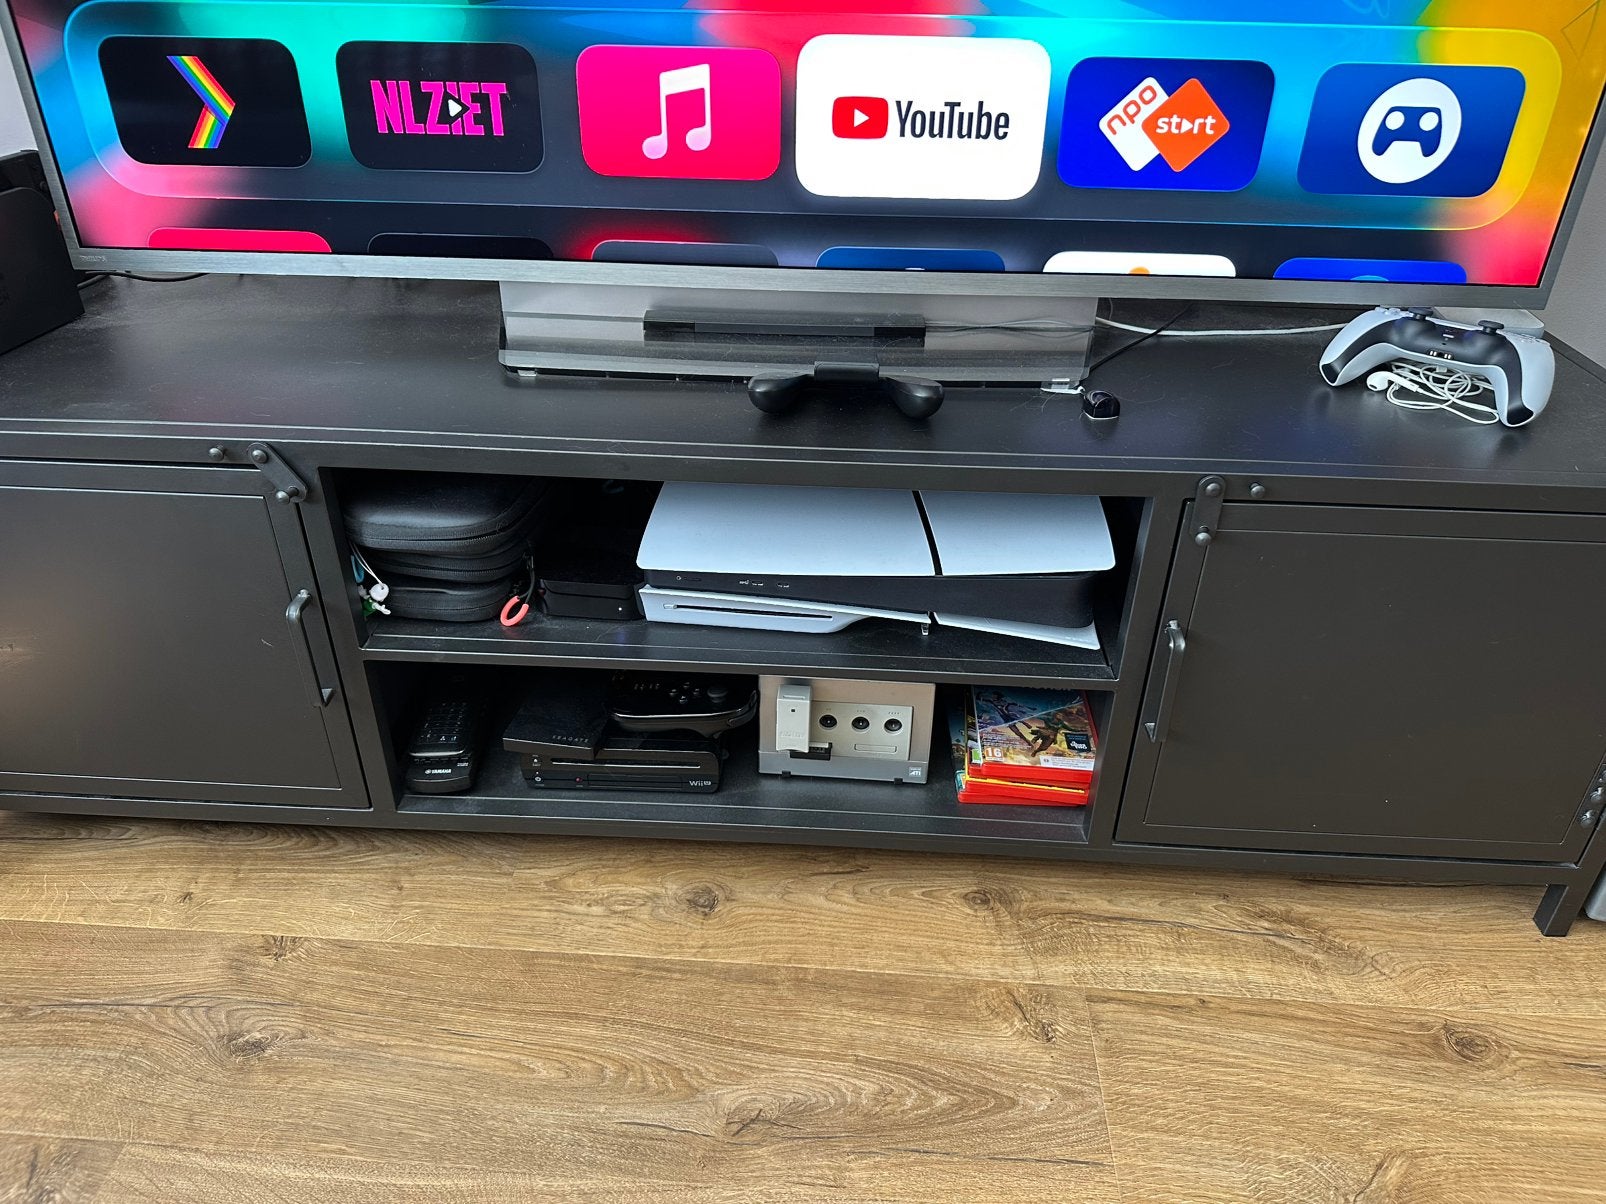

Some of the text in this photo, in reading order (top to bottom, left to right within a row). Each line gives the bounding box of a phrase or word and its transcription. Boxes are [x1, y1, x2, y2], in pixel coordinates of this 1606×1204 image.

[370, 79, 507, 136] NLZIET
[895, 100, 1010, 140] YouTube
[1107, 84, 1157, 135] npo
[1155, 114, 1216, 135] start
[985, 747, 1002, 758] 16
